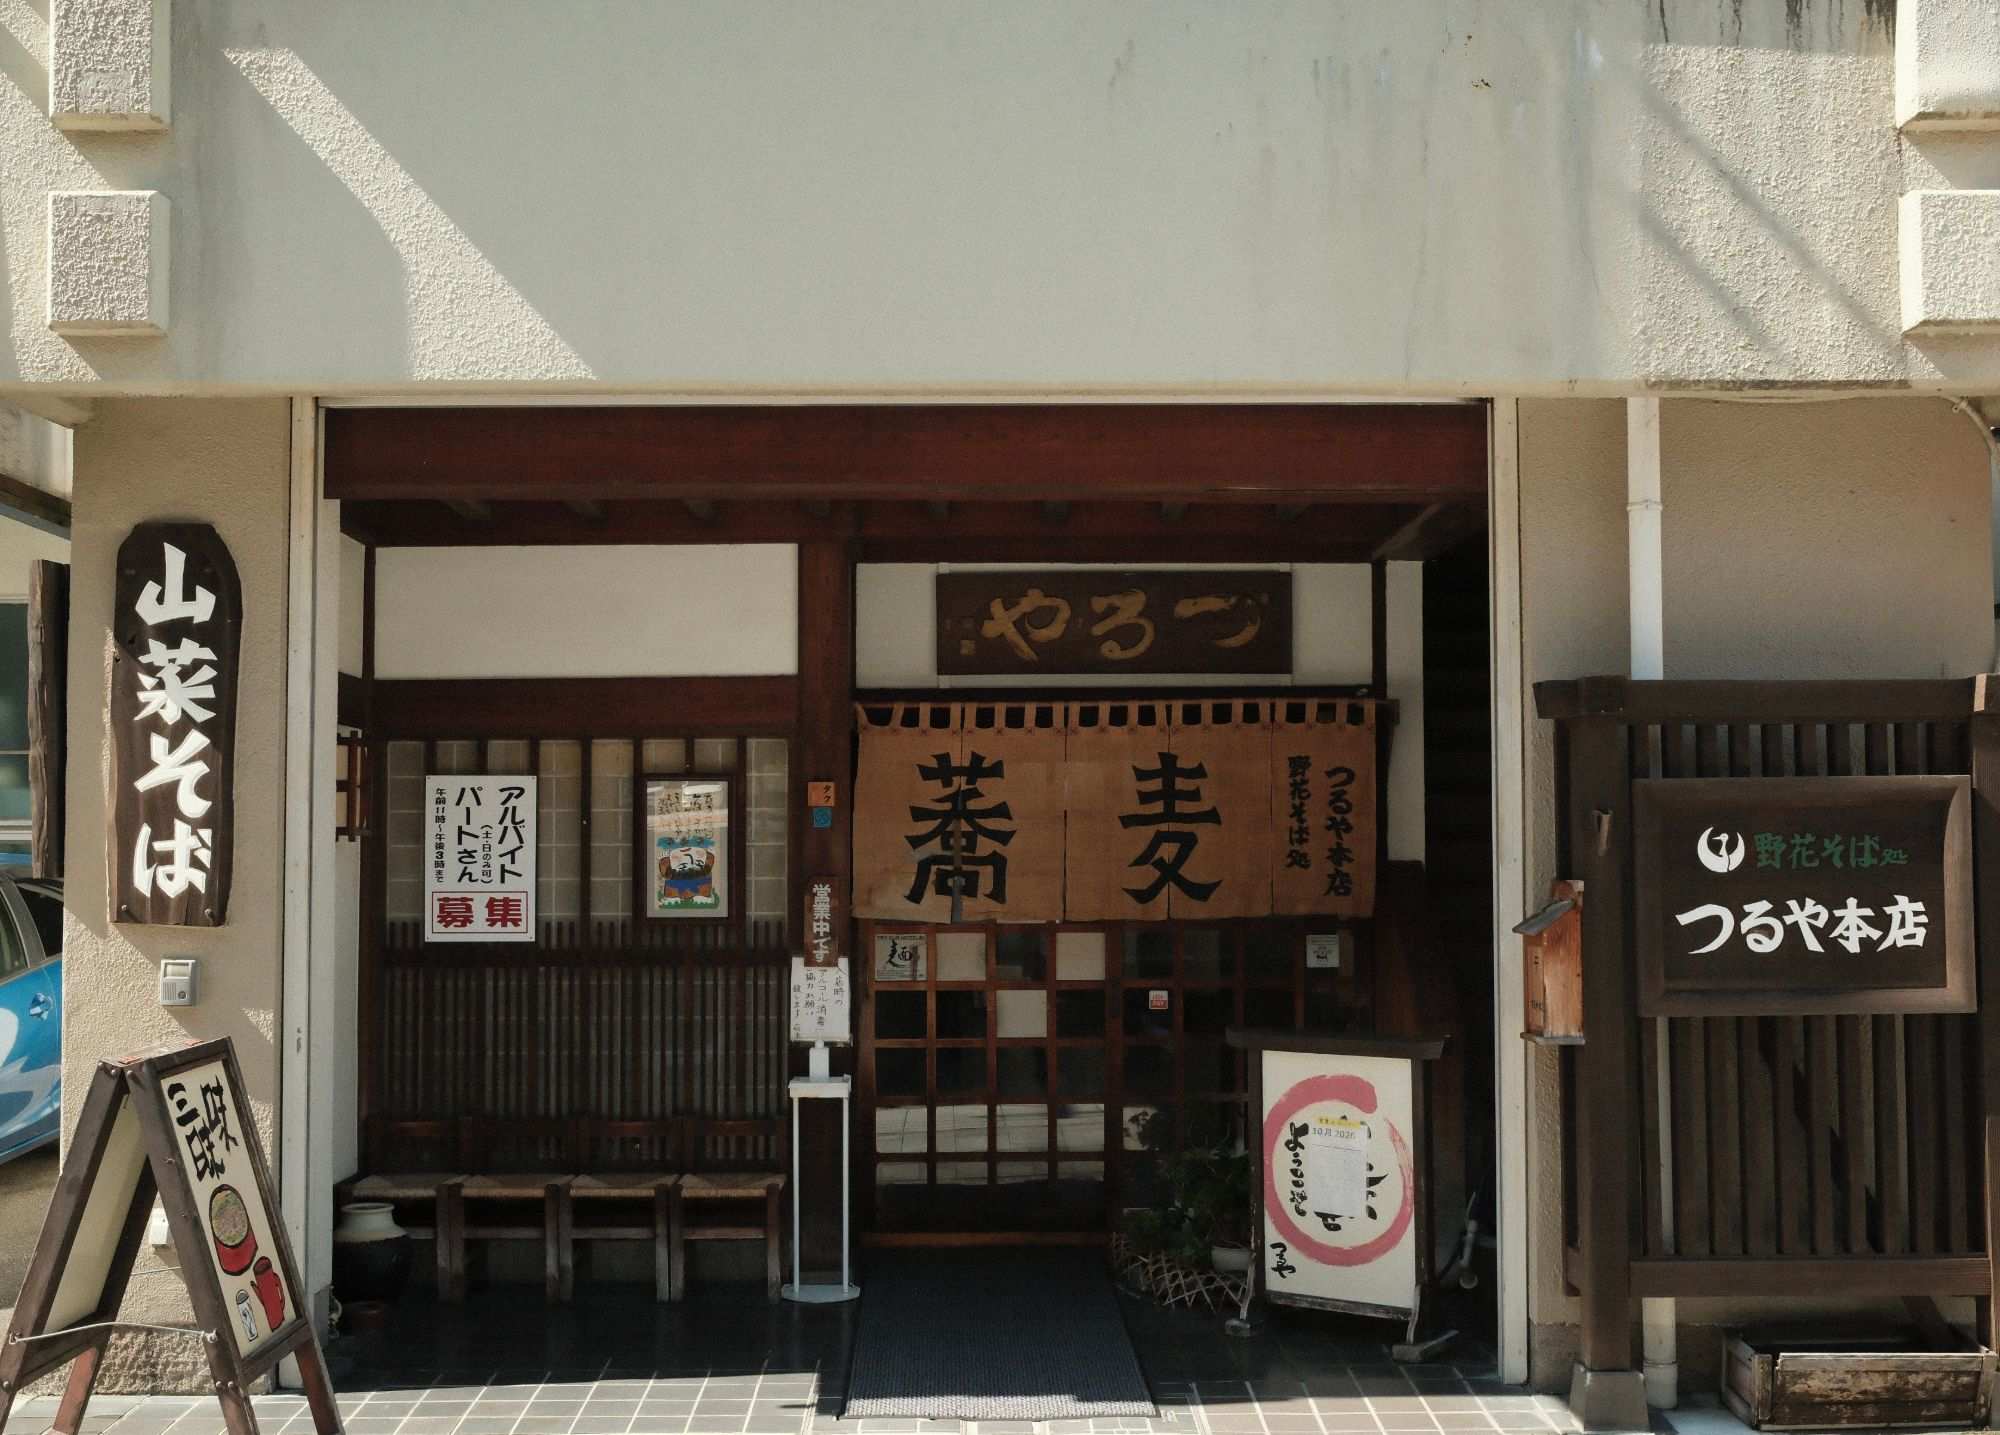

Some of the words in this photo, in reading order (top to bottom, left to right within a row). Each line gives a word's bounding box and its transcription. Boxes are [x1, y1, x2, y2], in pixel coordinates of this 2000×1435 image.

[134, 541, 218, 898] 山菜そば
[455, 786, 483, 884] パートさん
[498, 786, 526, 884] アルバイト
[904, 751, 1224, 905] 蕎麦
[1286, 755, 1312, 870] 野花そば処
[1323, 766, 1356, 897] つるや本店
[1753, 832, 1909, 871] 野花そば処
[436, 896, 522, 928] 募集
[811, 884, 832, 964] 営業中です
[1675, 895, 1930, 954] つるや本店
